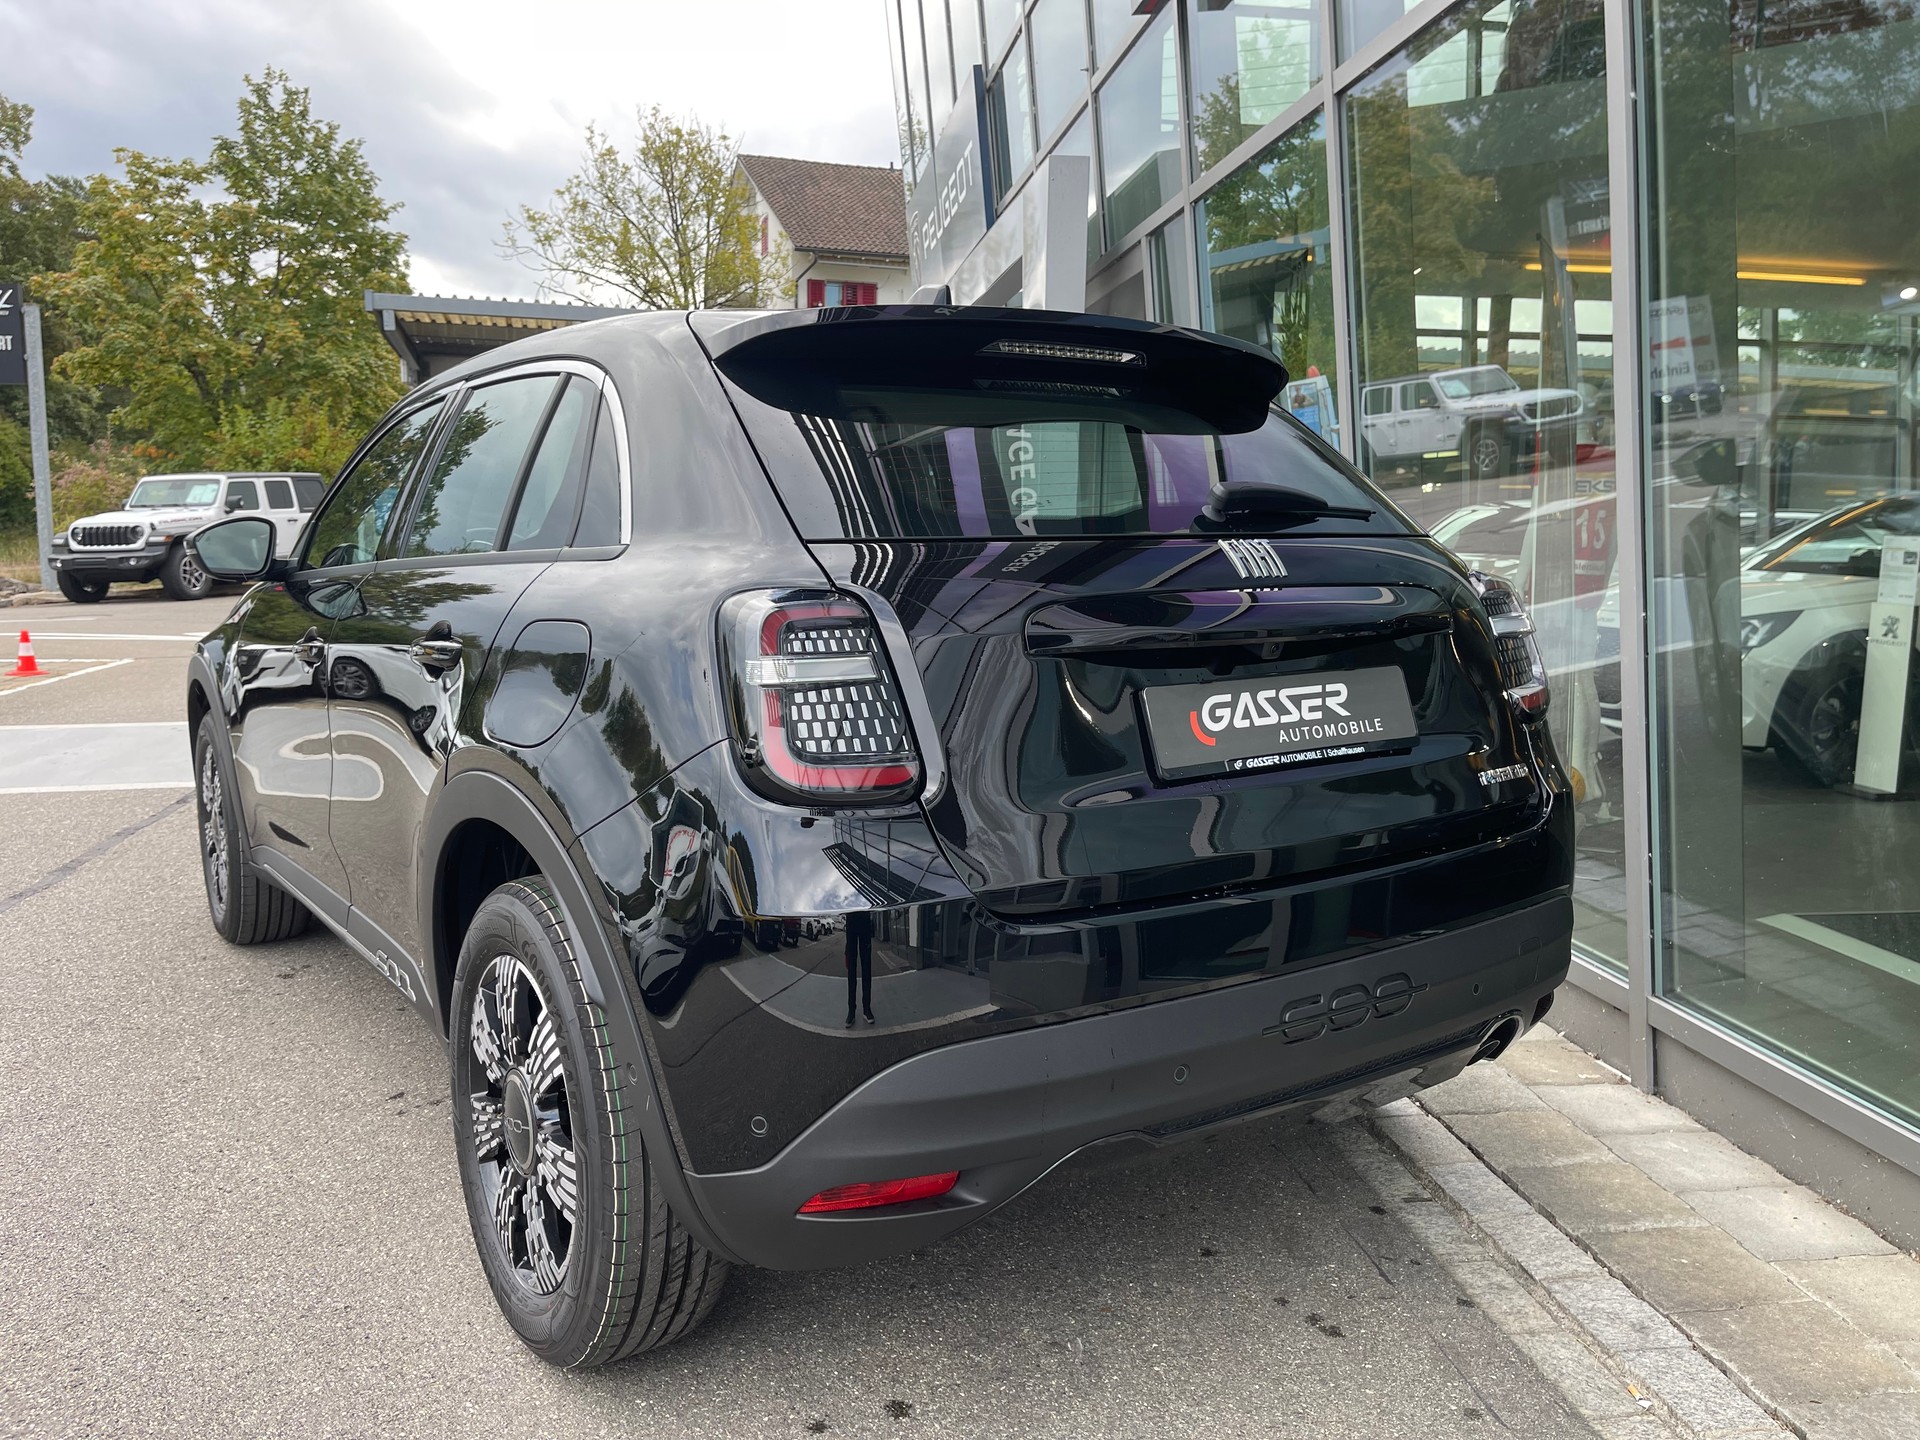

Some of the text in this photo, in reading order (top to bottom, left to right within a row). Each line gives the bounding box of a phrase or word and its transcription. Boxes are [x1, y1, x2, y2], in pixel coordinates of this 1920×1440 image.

[922, 139, 973, 260] PEUGEOT
[1575, 508, 1607, 549] 15
[1218, 538, 1288, 579] FIAT
[1201, 682, 1352, 732] GASSER
[1279, 718, 1384, 743] AUTOMOBILE
[1246, 755, 1281, 768] GASSER
[1281, 750, 1323, 763] AUTOMOBILE
[1328, 746, 1366, 757] Schaffhausen
[1274, 971, 1420, 1046] 600
